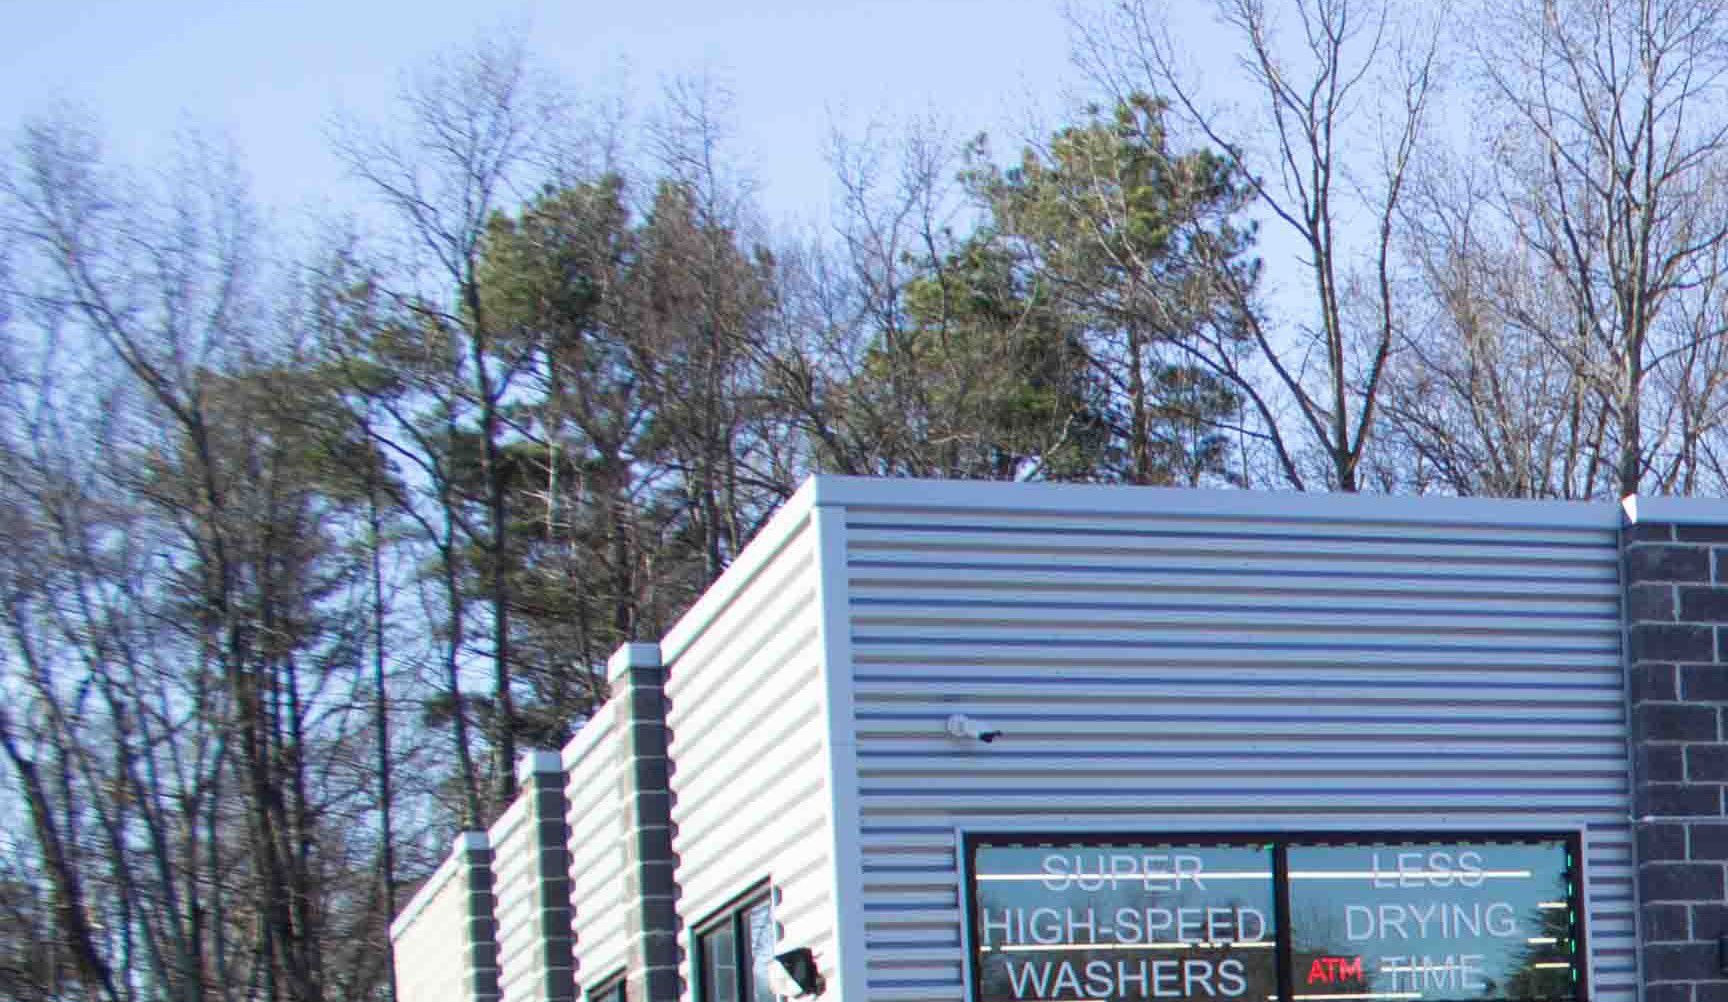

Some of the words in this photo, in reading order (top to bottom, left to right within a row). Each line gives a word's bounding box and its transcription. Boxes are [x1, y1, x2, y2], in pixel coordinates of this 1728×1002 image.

[1042, 854, 1207, 892] SUPER
[1372, 852, 1485, 890] LESS
[982, 906, 1267, 944] HIGH-SPEED
[1345, 902, 1519, 941] DRYING
[1006, 959, 1248, 999] WASHERS
[1307, 955, 1364, 984] ATM
[1380, 952, 1488, 992] TIME
